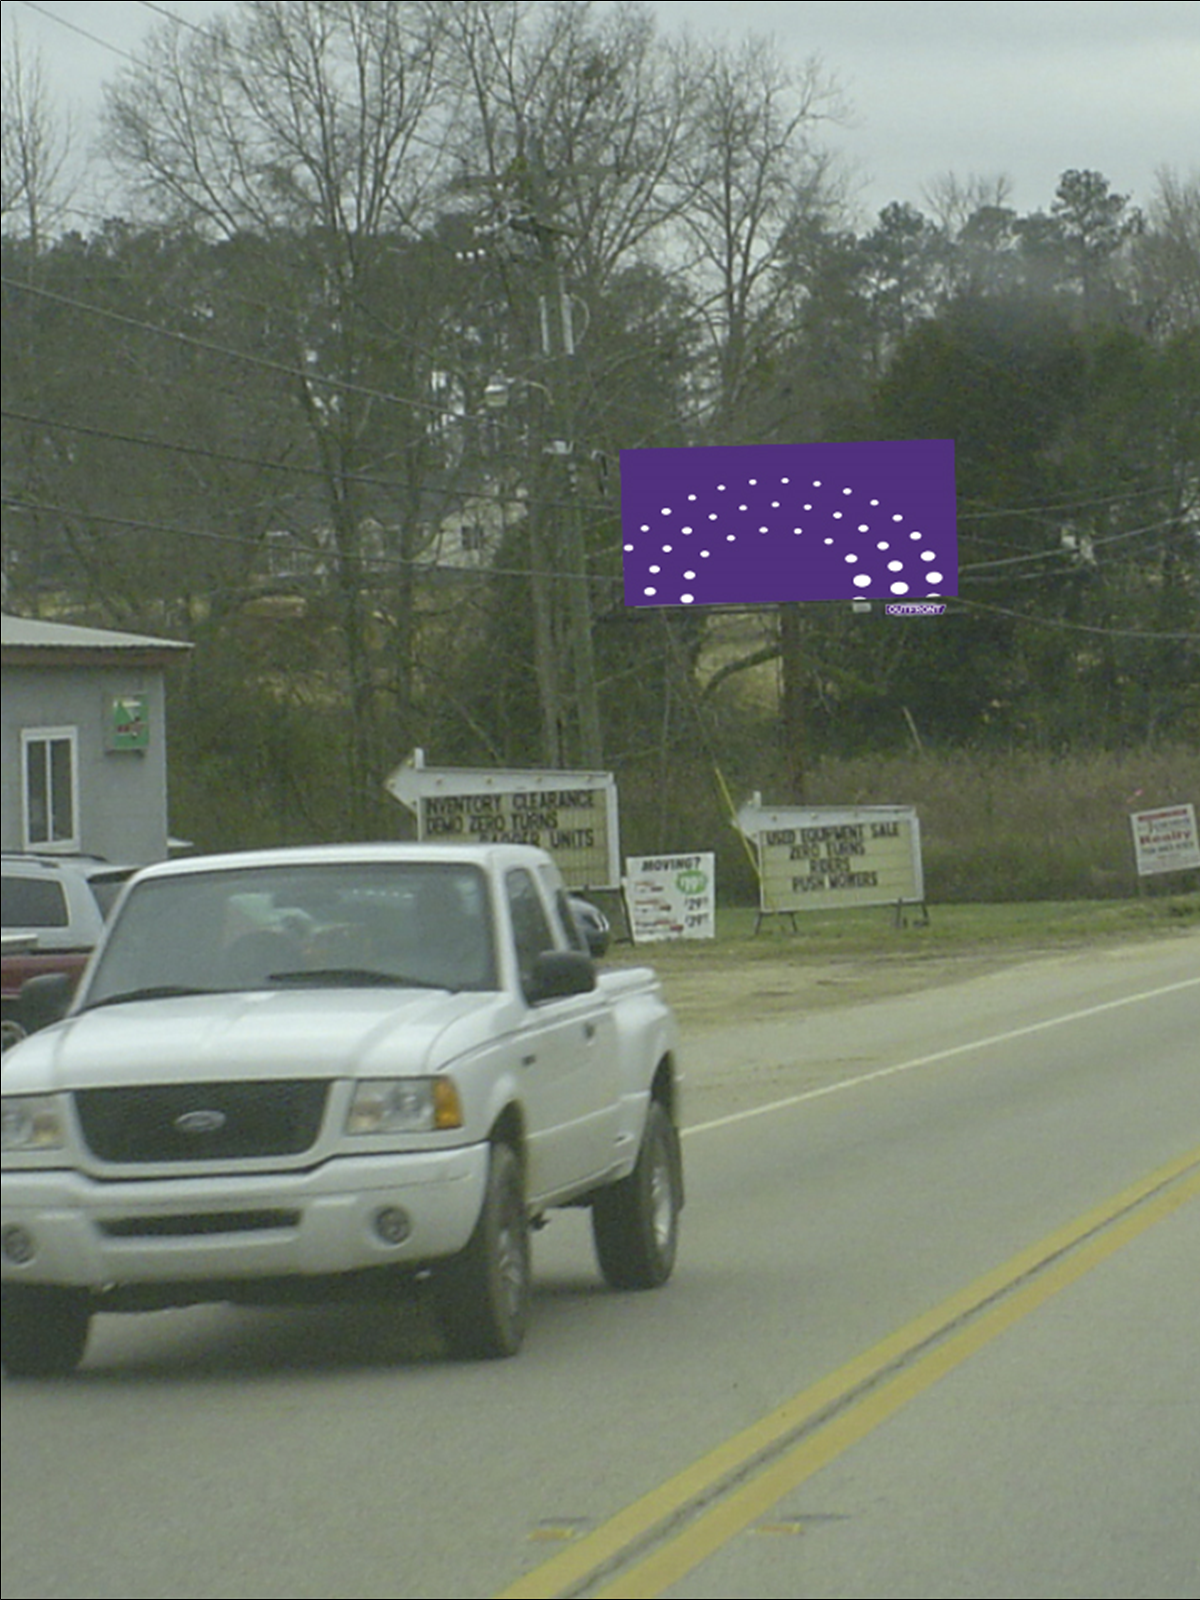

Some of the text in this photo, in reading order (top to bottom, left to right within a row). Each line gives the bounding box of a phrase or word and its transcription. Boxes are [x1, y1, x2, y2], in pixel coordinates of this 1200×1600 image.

[888, 603, 940, 615] OUTFRONT
[426, 790, 594, 814] INVENTORY CLEARANCE
[427, 811, 559, 834] DEMO ZERO TURNS
[551, 828, 595, 848] UNITS
[768, 830, 795, 845] USED
[871, 822, 898, 837] SALE
[790, 843, 820, 861] ZERO
[641, 856, 701, 872] MOVING?
[809, 856, 851, 874] RIDERS
